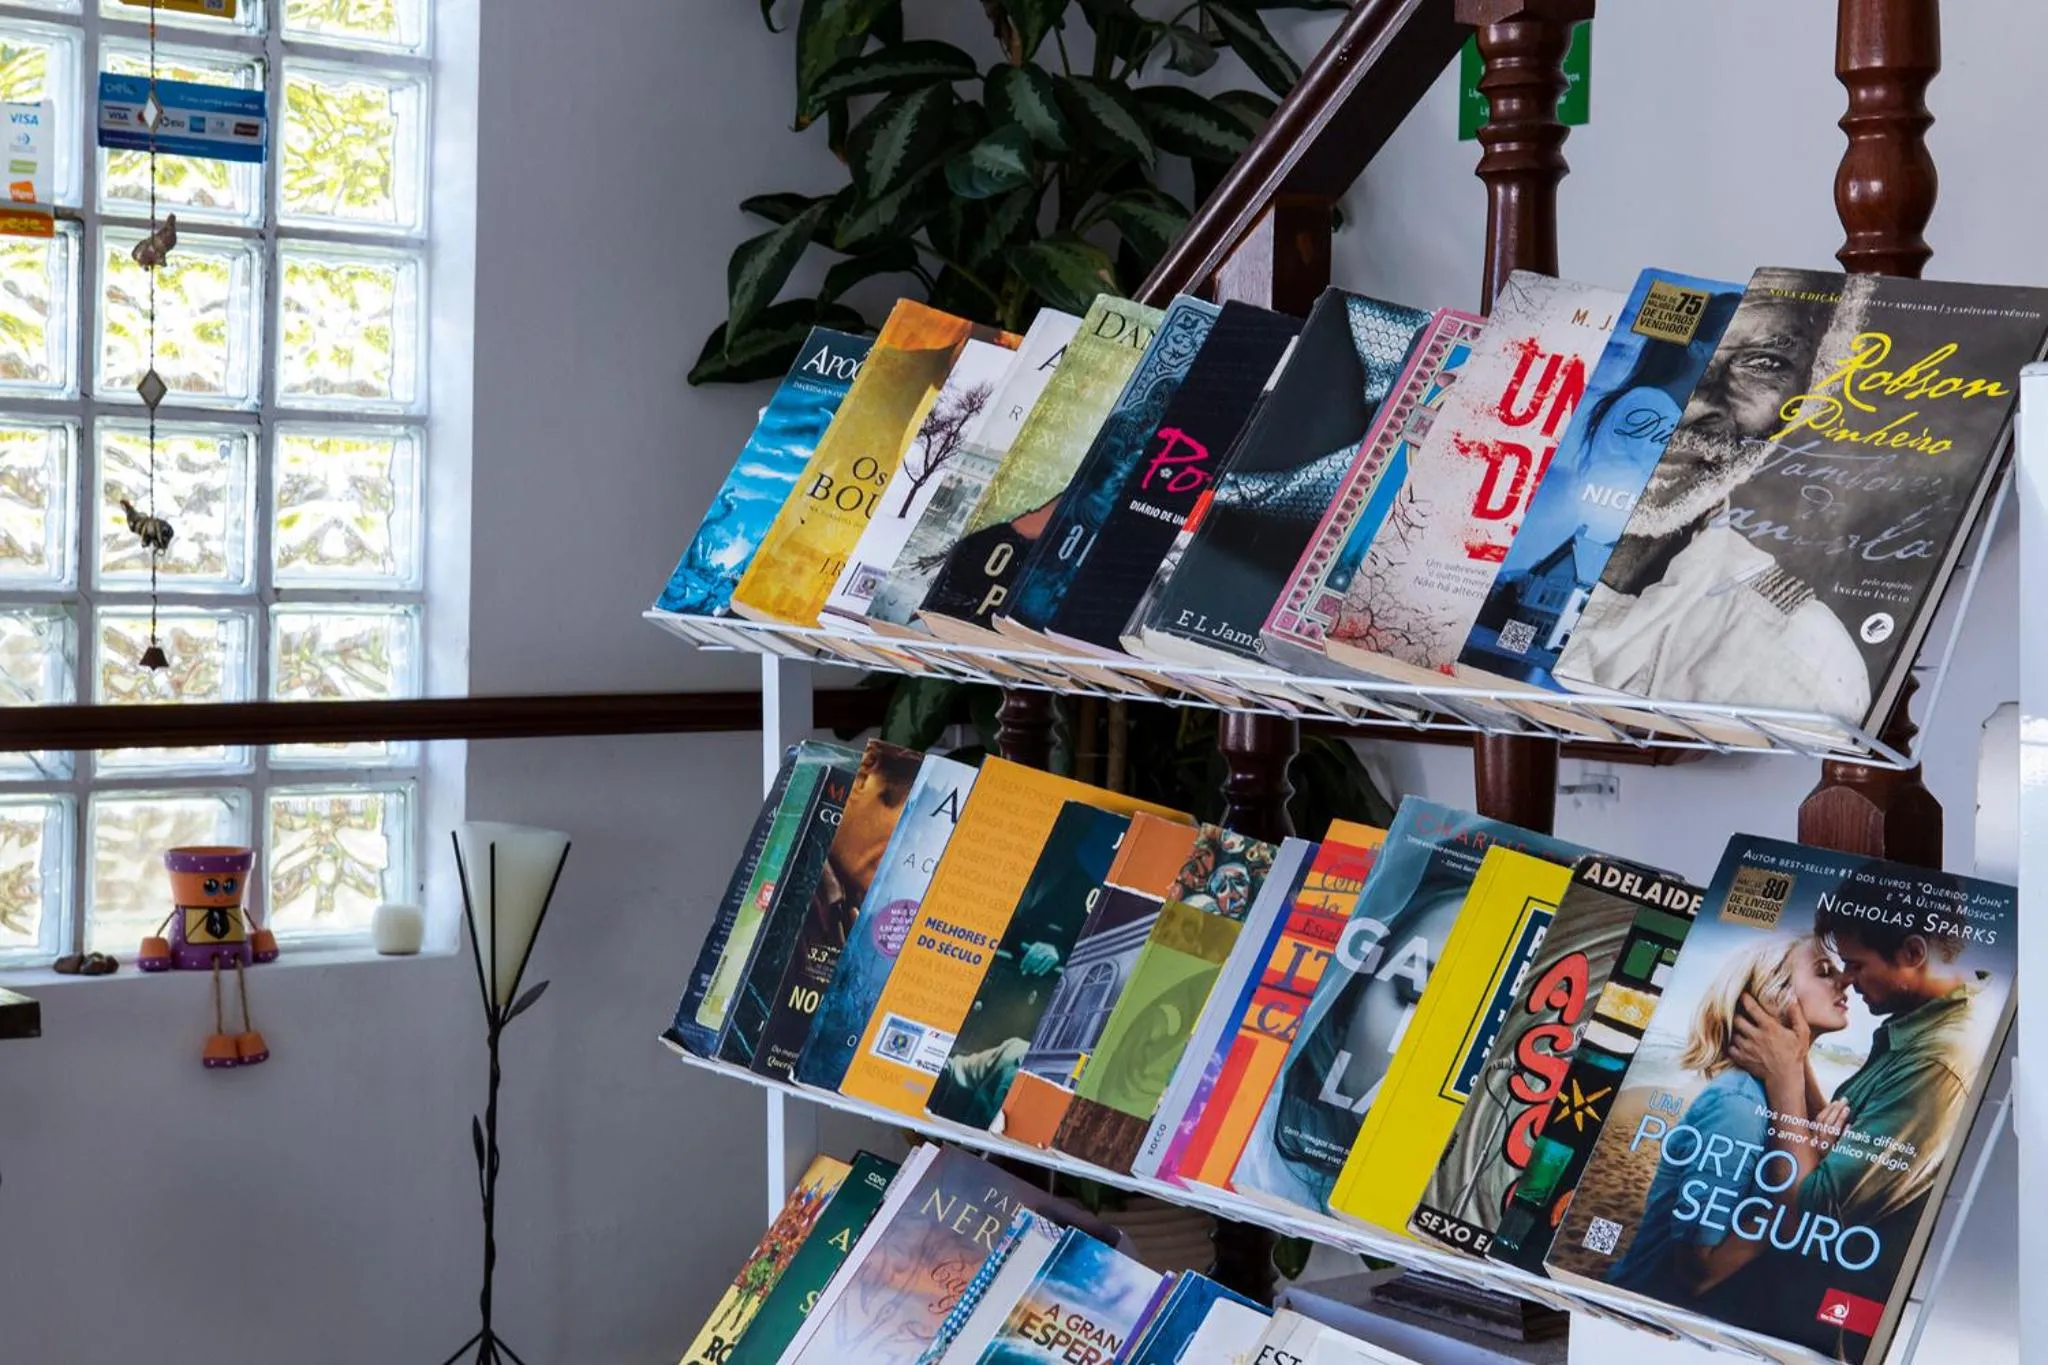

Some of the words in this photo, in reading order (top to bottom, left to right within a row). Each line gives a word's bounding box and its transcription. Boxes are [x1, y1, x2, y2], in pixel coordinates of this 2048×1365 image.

[10, 112, 39, 125] VISA
[1643, 307, 1658, 318] DE
[1660, 311, 1694, 325] LIVROS
[1675, 291, 1704, 315] 75
[1640, 316, 1690, 336] VENDIDOS
[1813, 332, 2010, 413] Robson
[1769, 394, 1953, 456] Pinheiro
[852, 456, 888, 487] Os
[1129, 499, 1161, 518] DIÁRIO
[1160, 510, 1173, 524] DE
[984, 542, 1014, 577] O
[1176, 609, 1194, 627] E
[1194, 615, 1207, 633] L
[1839, 867, 1852, 879] #1
[1583, 862, 1703, 916] ADELAIDE
[1745, 896, 1781, 913] LIVROS
[1762, 878, 1790, 900] 80
[1726, 903, 1777, 923] VENDIDOS
[924, 916, 987, 946] MELHORES
[917, 934, 936, 950] DO
[937, 941, 982, 966] SÉCULO
[1147, 1123, 1167, 1156] ROCCO
[1754, 1104, 1777, 1120] Nos
[1779, 1113, 1841, 1137] momentos
[1843, 1124, 1871, 1144] mais
[1873, 1133, 1918, 1158] difíceis,
[1628, 1114, 1799, 1194] PORTO
[1767, 1127, 1776, 1136] o
[1777, 1129, 1809, 1145] amor
[1810, 1136, 1819, 1148] é
[1820, 1139, 1829, 1150] o
[1831, 1141, 1864, 1159] único
[1865, 1151, 1912, 1173] refúgio.
[1418, 1211, 1471, 1243] SEXO
[1671, 1179, 1881, 1272] SEGURO
[1043, 1303, 1060, 1322] A
[1066, 1314, 1123, 1354] GRAN
